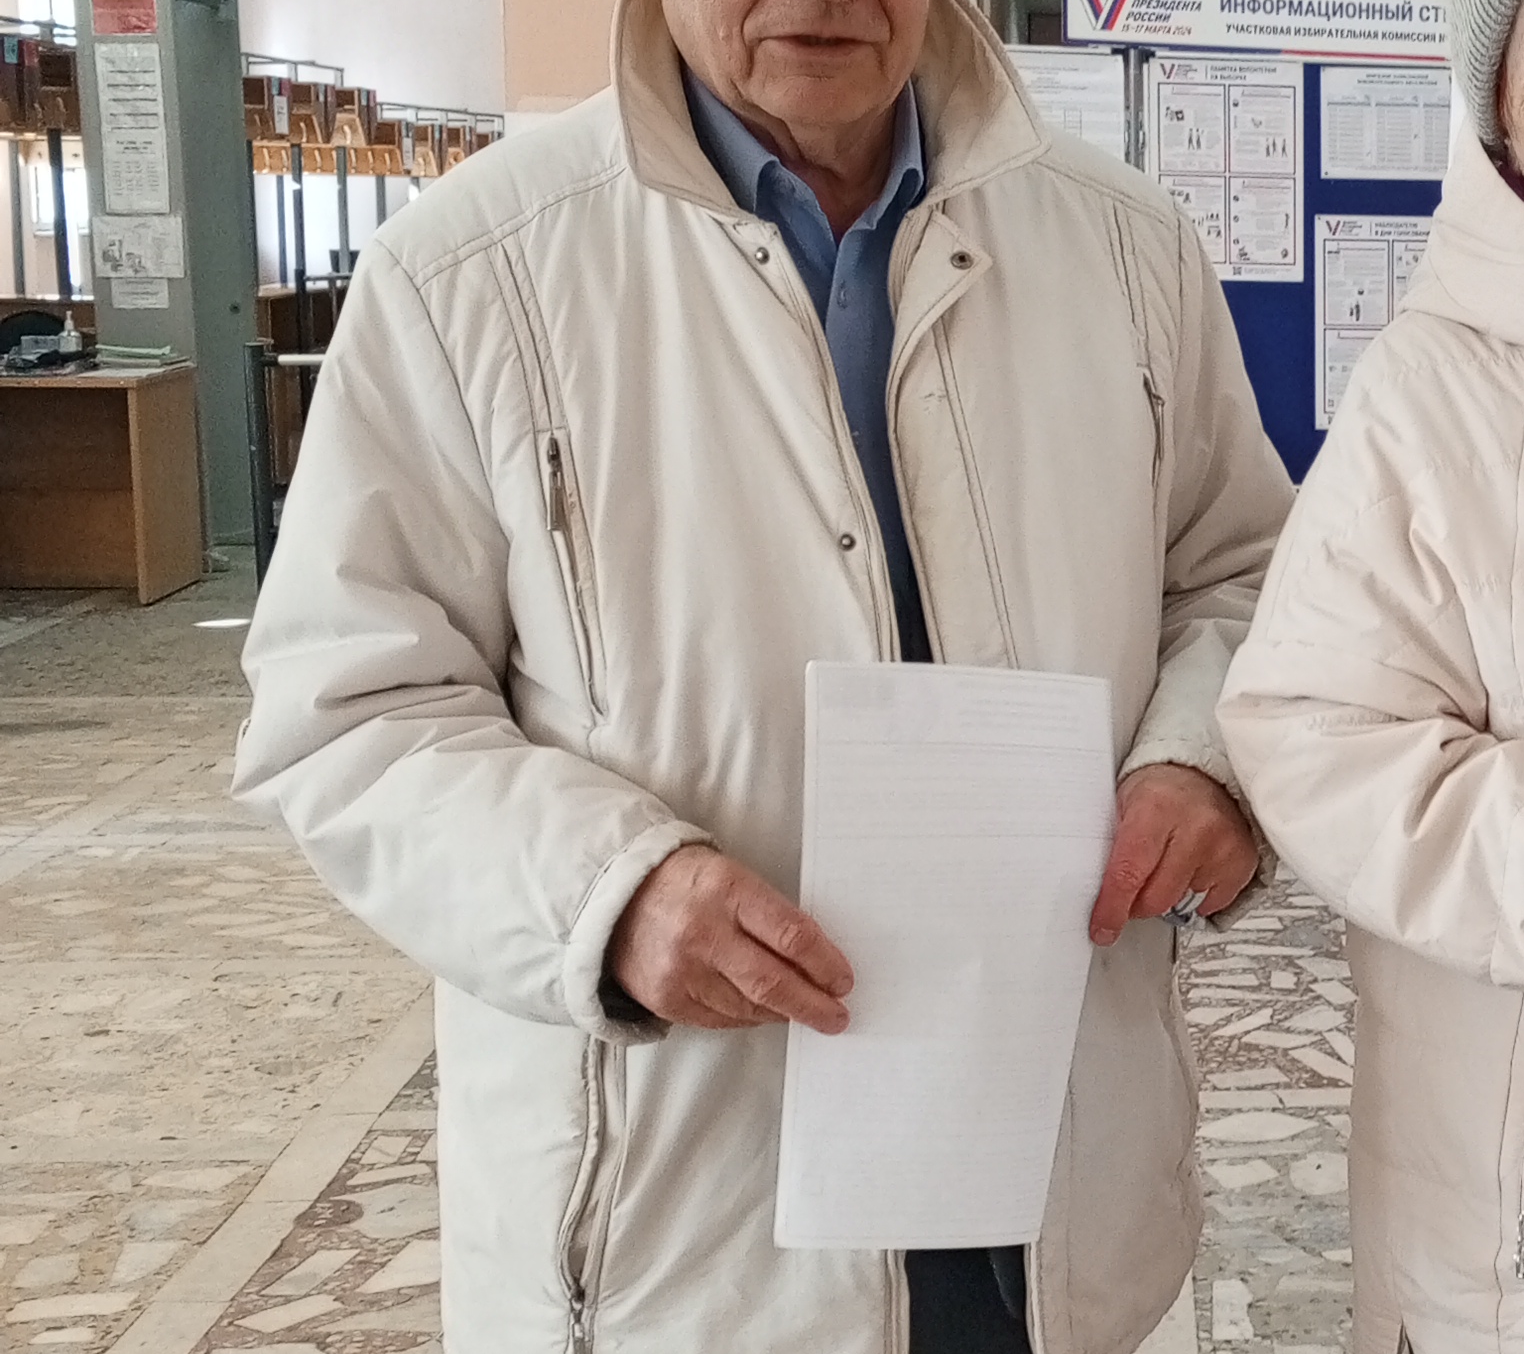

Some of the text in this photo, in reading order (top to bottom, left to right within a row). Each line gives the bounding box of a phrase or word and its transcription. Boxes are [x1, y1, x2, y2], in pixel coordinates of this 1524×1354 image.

[1124, 11, 1172, 23] РОССИИ
[1143, 25, 1172, 36] МАРТА
[1225, 23, 1292, 37] УЧАСТКОВАЯ
[1293, 26, 1379, 40] ИЗБИРАТЕЛЬНАЯ
[1380, 29, 1437, 43] КОМИССИЯ
